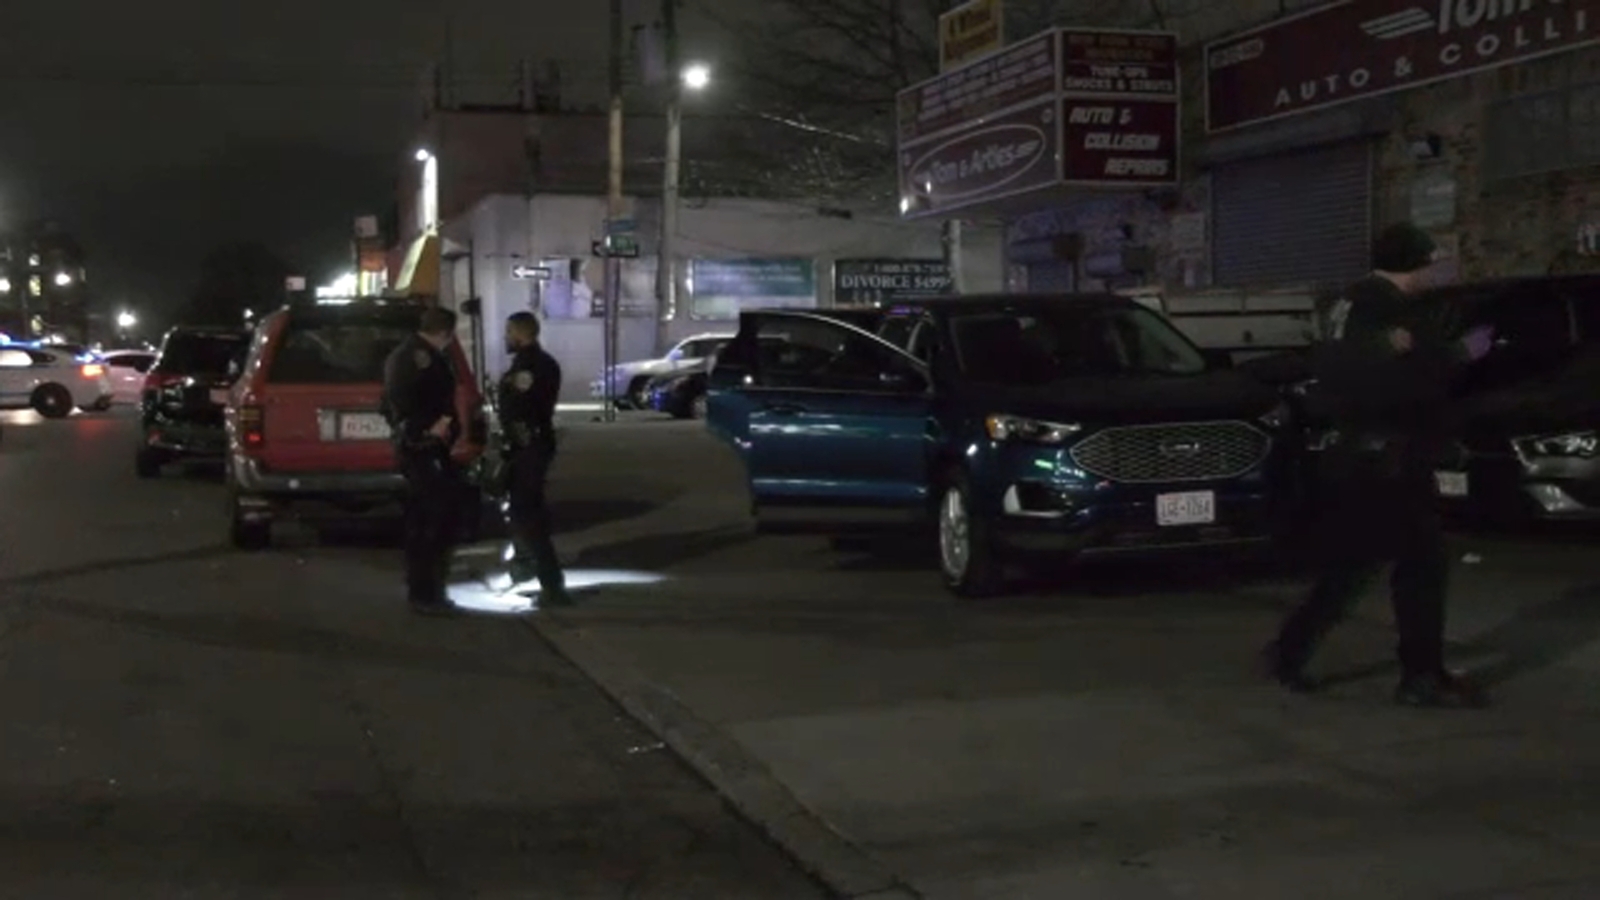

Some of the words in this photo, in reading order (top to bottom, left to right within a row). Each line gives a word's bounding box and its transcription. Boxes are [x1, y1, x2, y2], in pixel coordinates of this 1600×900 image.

[1273, 67, 1371, 108] AUTO
[1394, 55, 1413, 77] &
[1438, 9, 1587, 65] COLLI
[1064, 77, 1112, 90] SHOCKS
[1116, 79, 1126, 91] &
[1069, 106, 1115, 124] AUTO
[1119, 107, 1132, 125] &
[1084, 132, 1161, 151] COLLISION
[1104, 157, 1169, 176] REPAIRS
[841, 274, 911, 289] DIVORCE
